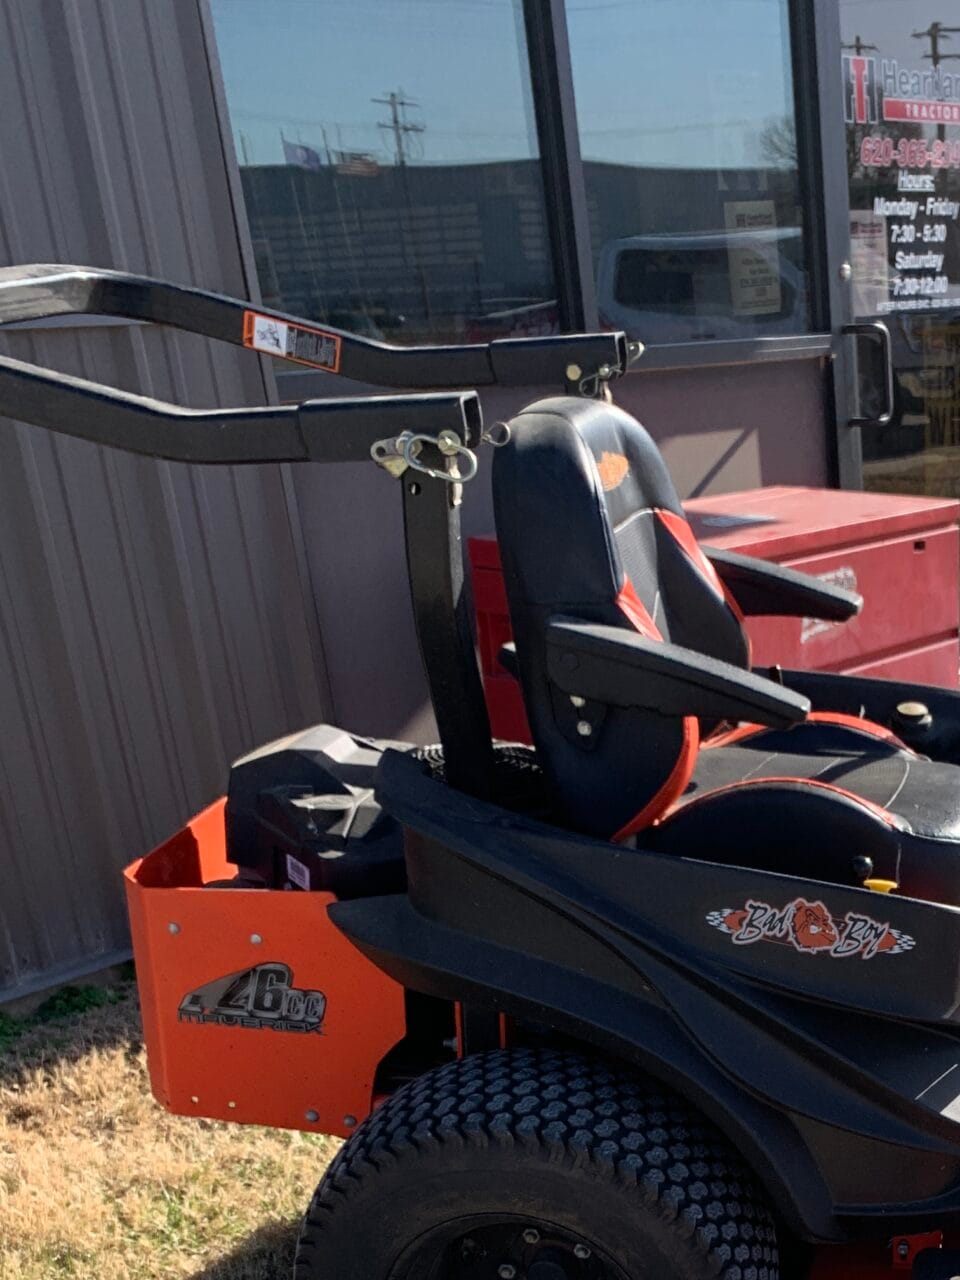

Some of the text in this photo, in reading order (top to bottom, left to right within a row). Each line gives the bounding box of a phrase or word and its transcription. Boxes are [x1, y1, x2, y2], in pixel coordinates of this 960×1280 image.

[904, 102, 960, 120] TRACTOR
[874, 197, 919, 220] Monday
[926, 197, 960, 220] Friday
[890, 224, 916, 243] 7:30
[922, 224, 947, 243] 5:30
[895, 251, 944, 272] Saturday
[732, 900, 889, 959] Bad Boy
